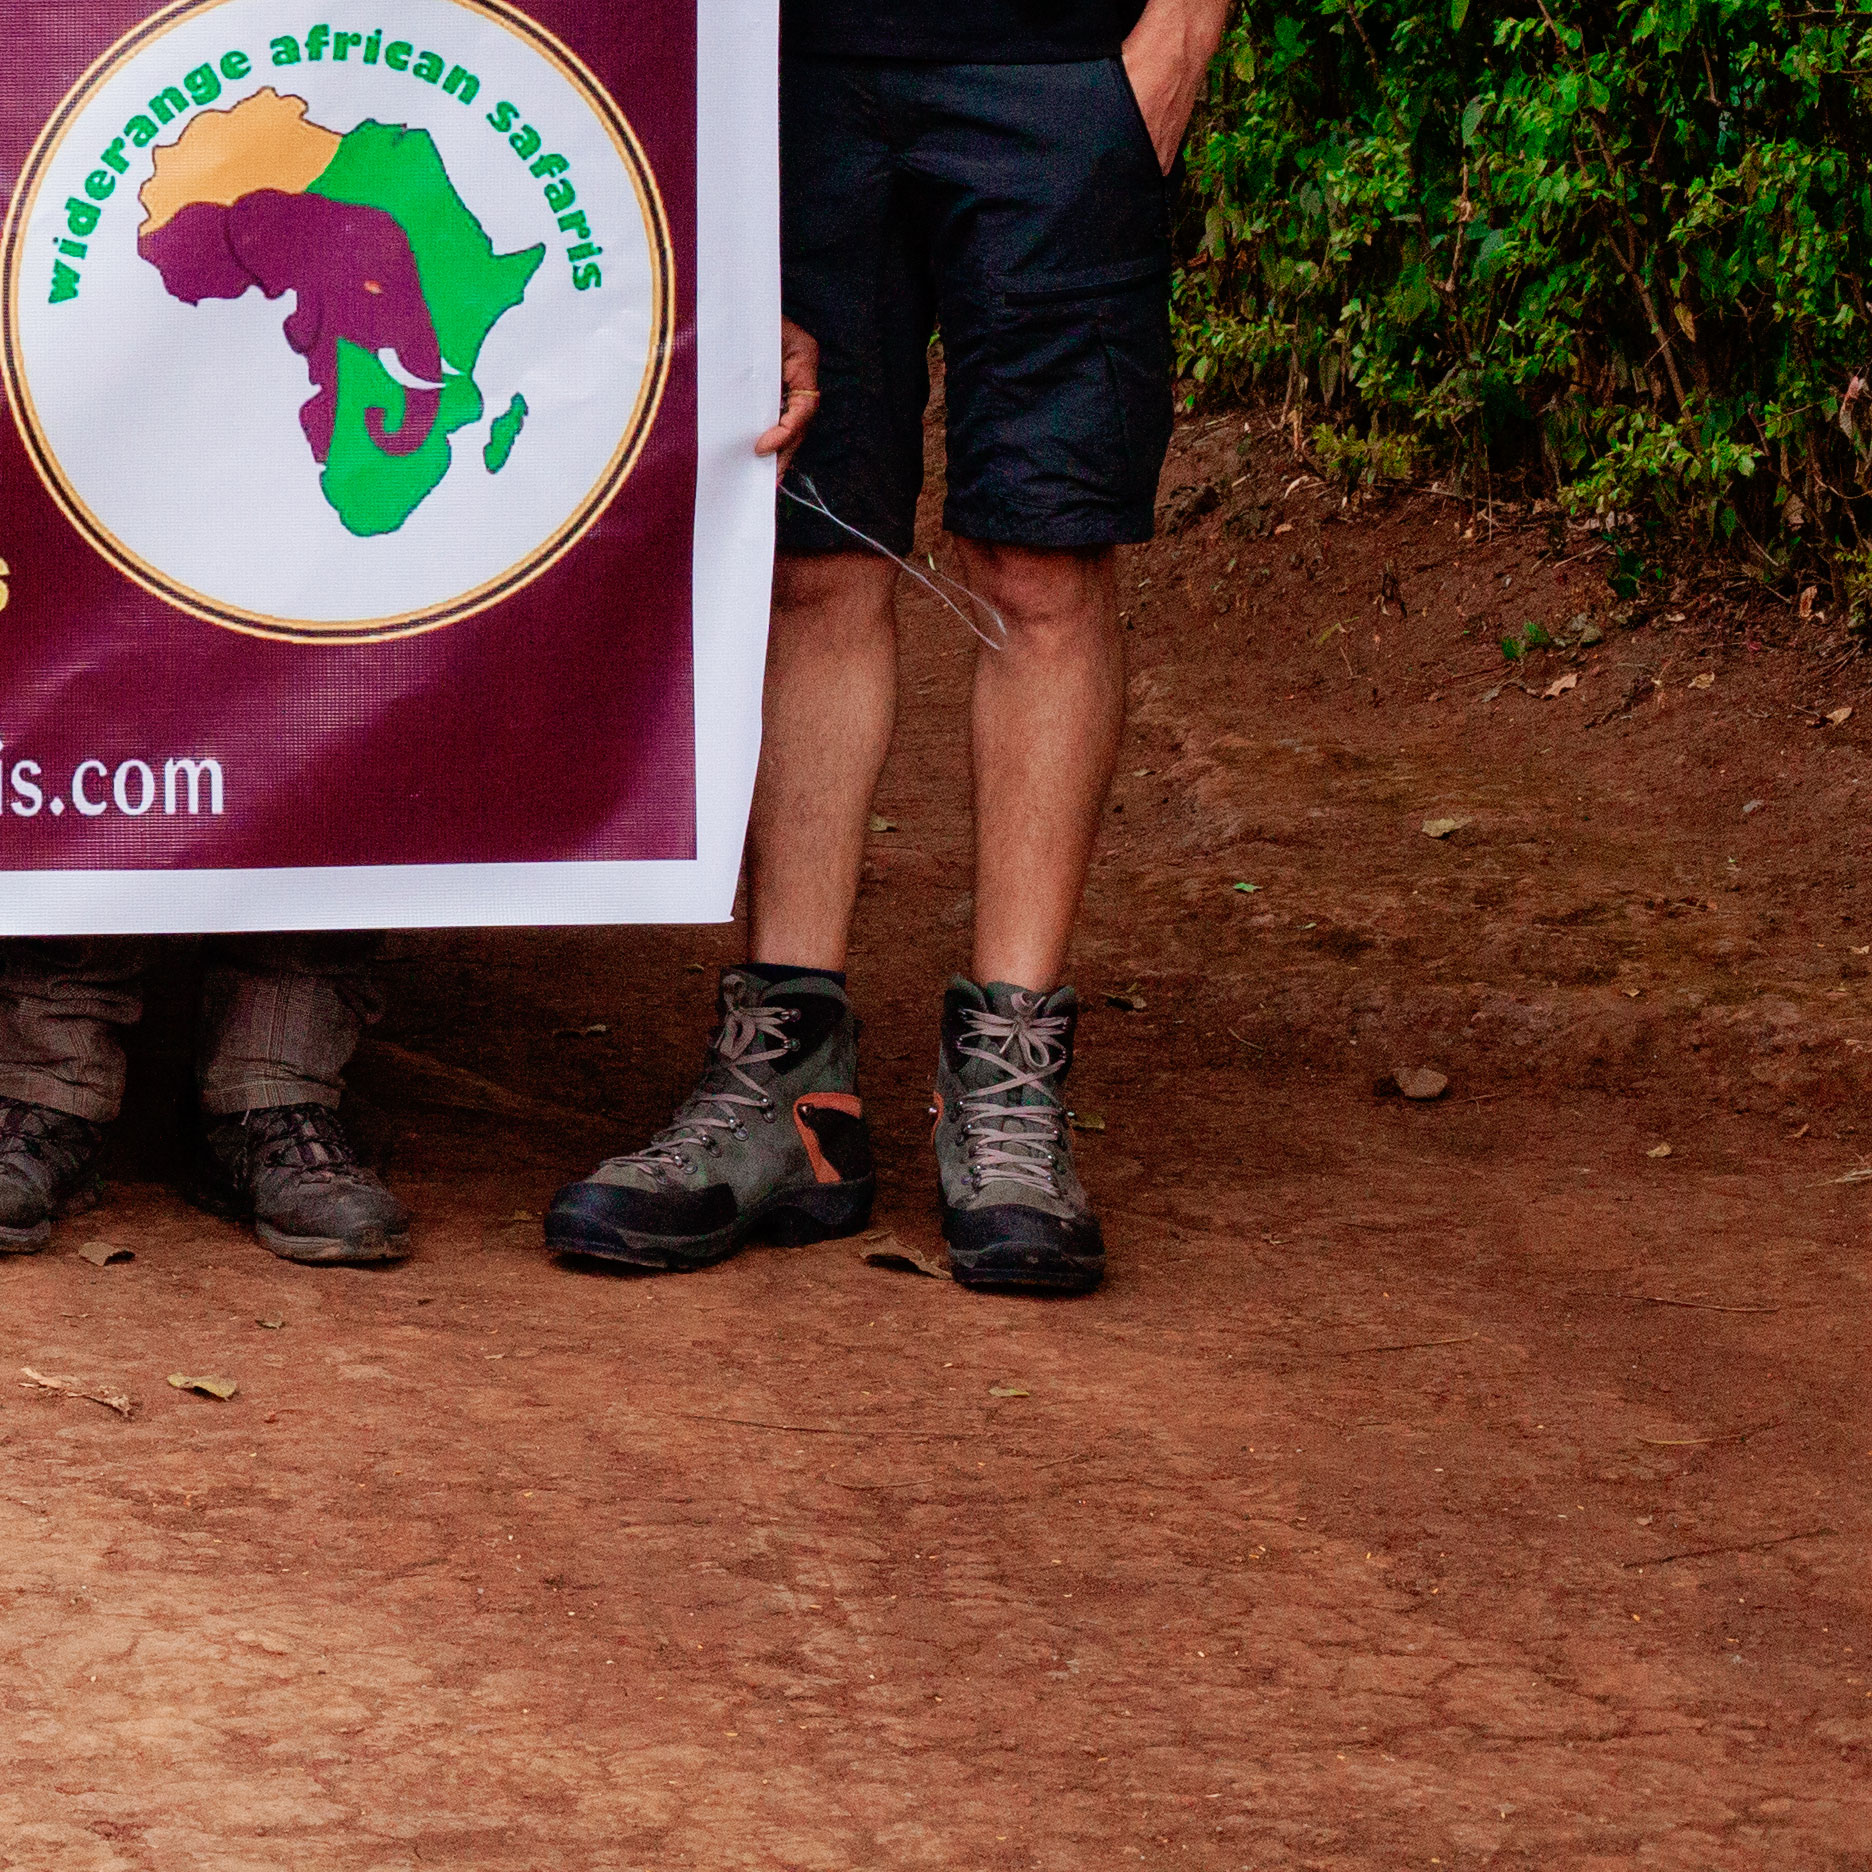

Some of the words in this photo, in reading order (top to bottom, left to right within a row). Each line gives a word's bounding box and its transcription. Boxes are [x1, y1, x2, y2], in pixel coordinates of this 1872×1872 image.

[48, 48, 253, 304] widerange
[270, 23, 482, 104] african
[487, 100, 603, 293] safaris
